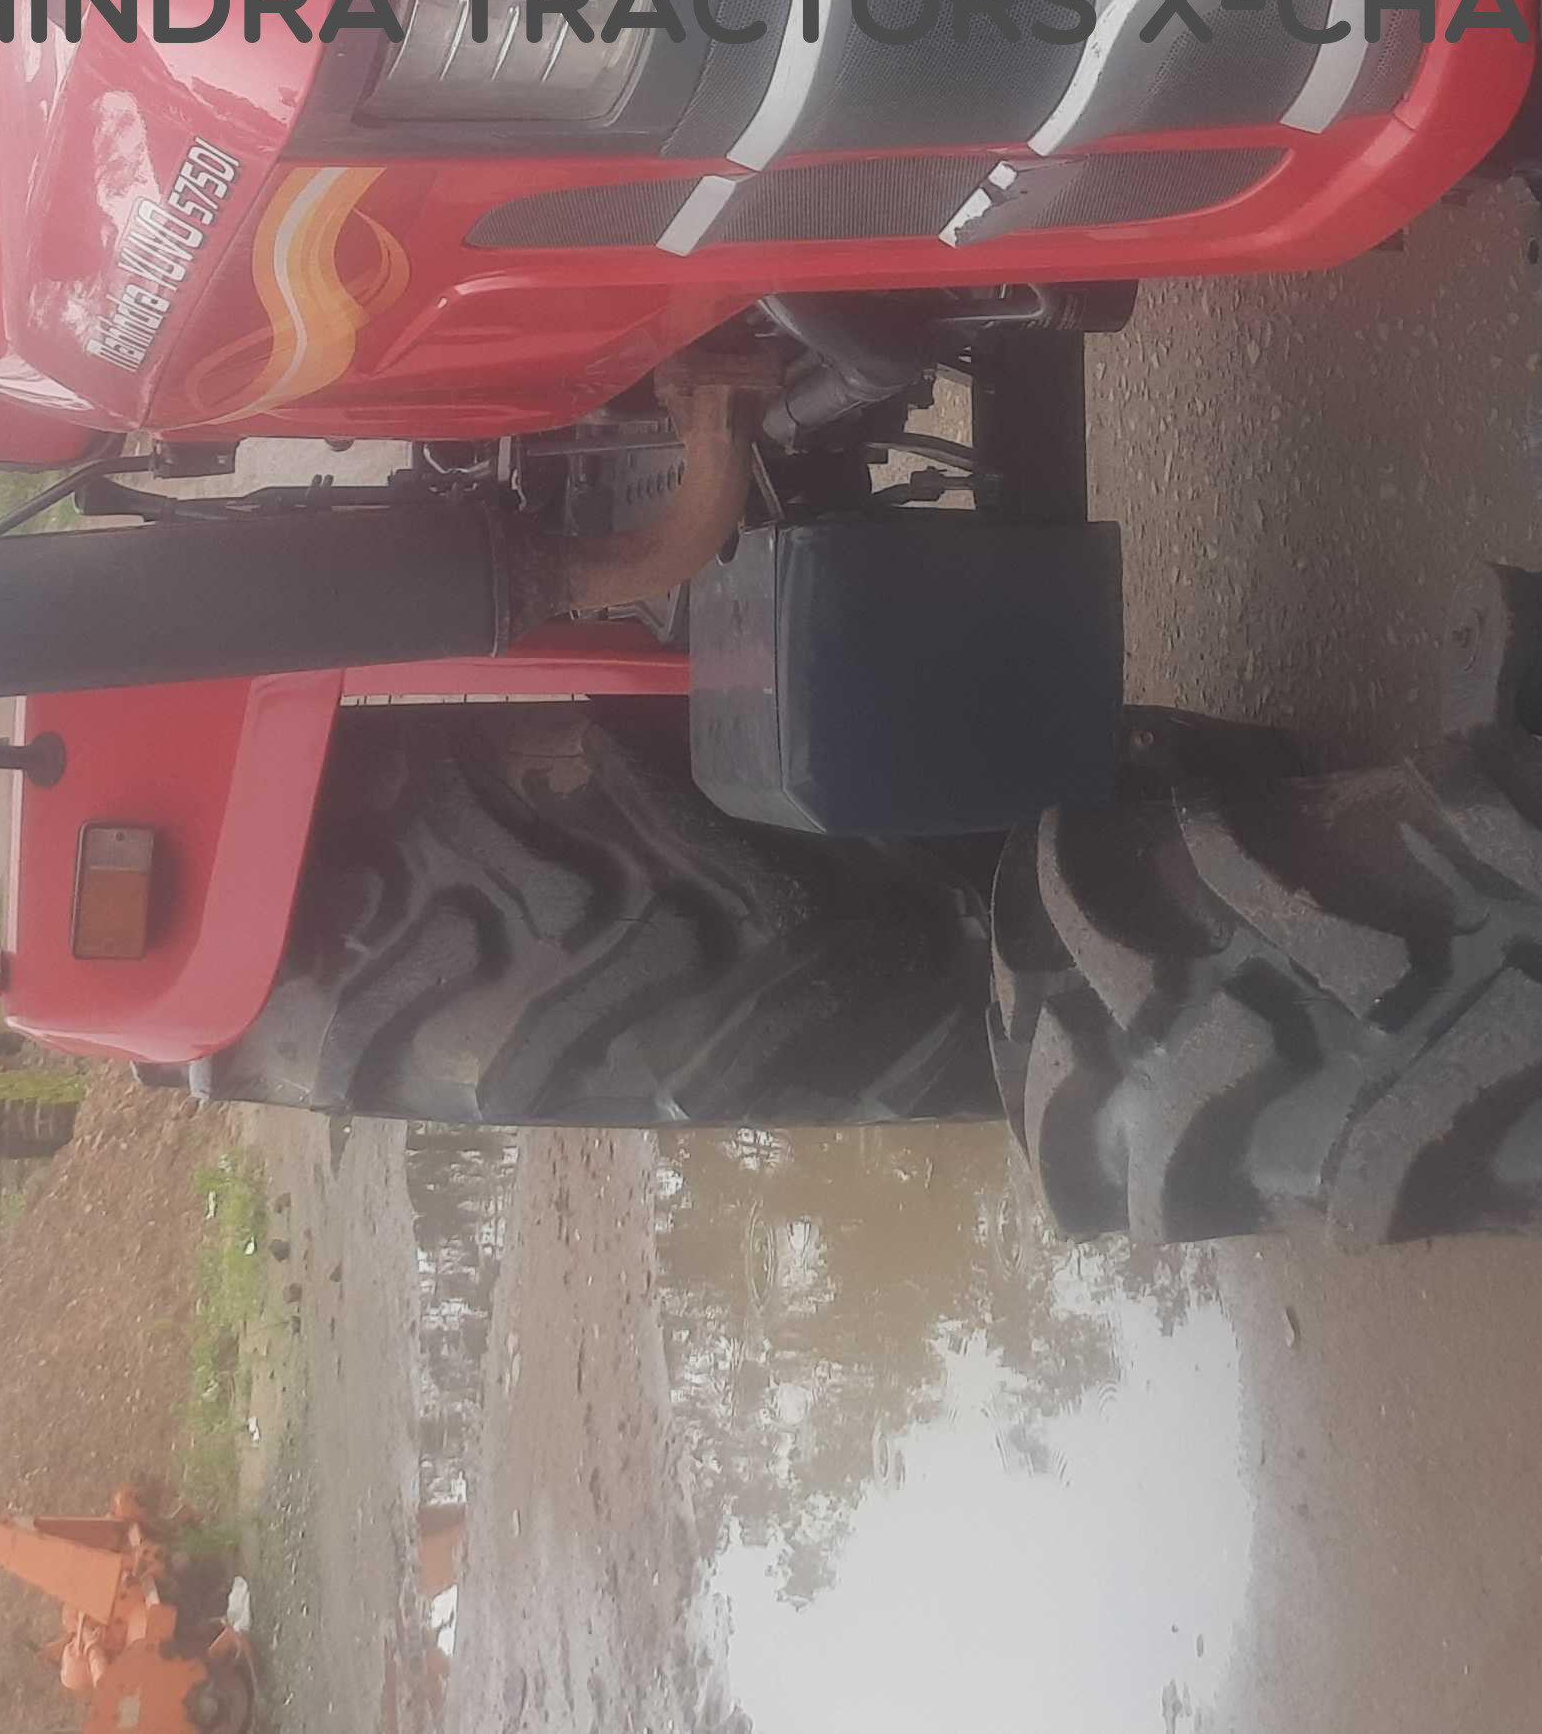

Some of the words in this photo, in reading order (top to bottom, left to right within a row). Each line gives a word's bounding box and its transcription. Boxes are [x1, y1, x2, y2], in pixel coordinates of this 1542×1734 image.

[166, 136, 241, 226] 575DI
[117, 199, 205, 292] YUVO
[85, 283, 171, 373] Mahindra
